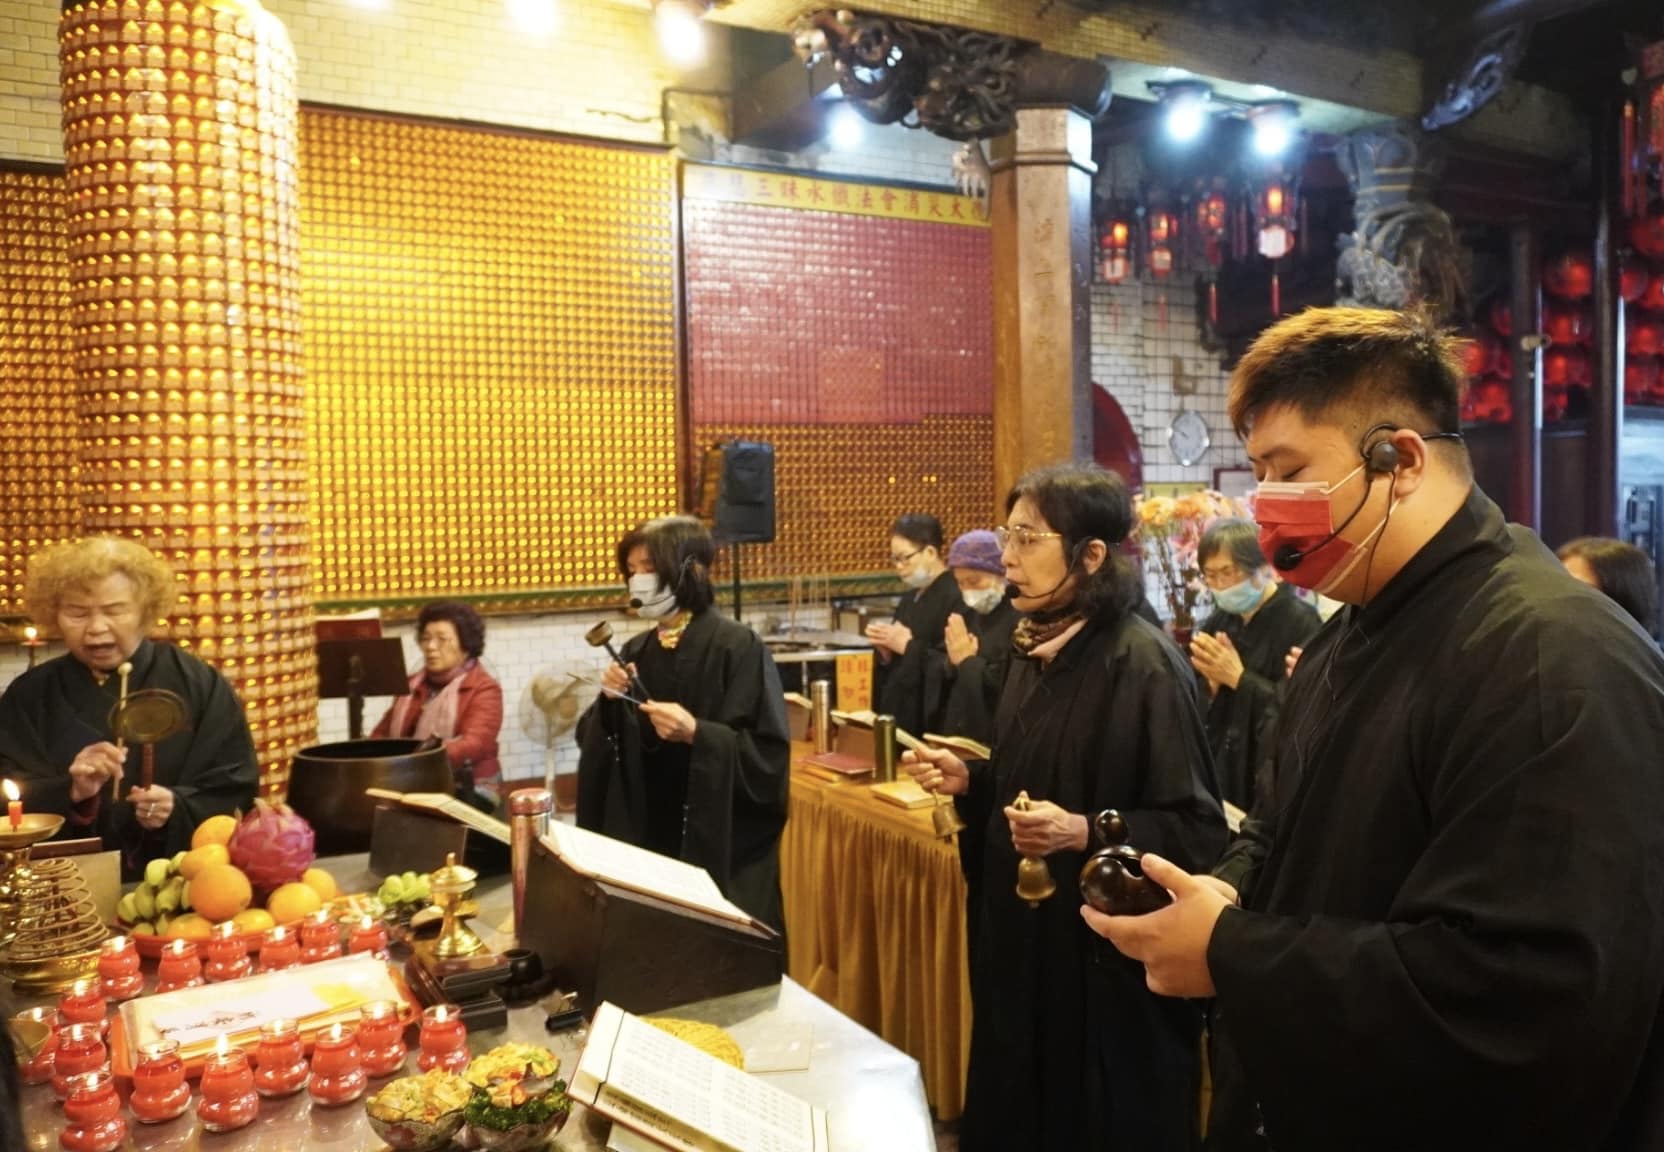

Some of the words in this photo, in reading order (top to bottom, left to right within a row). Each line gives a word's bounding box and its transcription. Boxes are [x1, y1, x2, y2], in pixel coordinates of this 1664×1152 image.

[703, 171, 986, 219] 三昧水懺法會消災大
